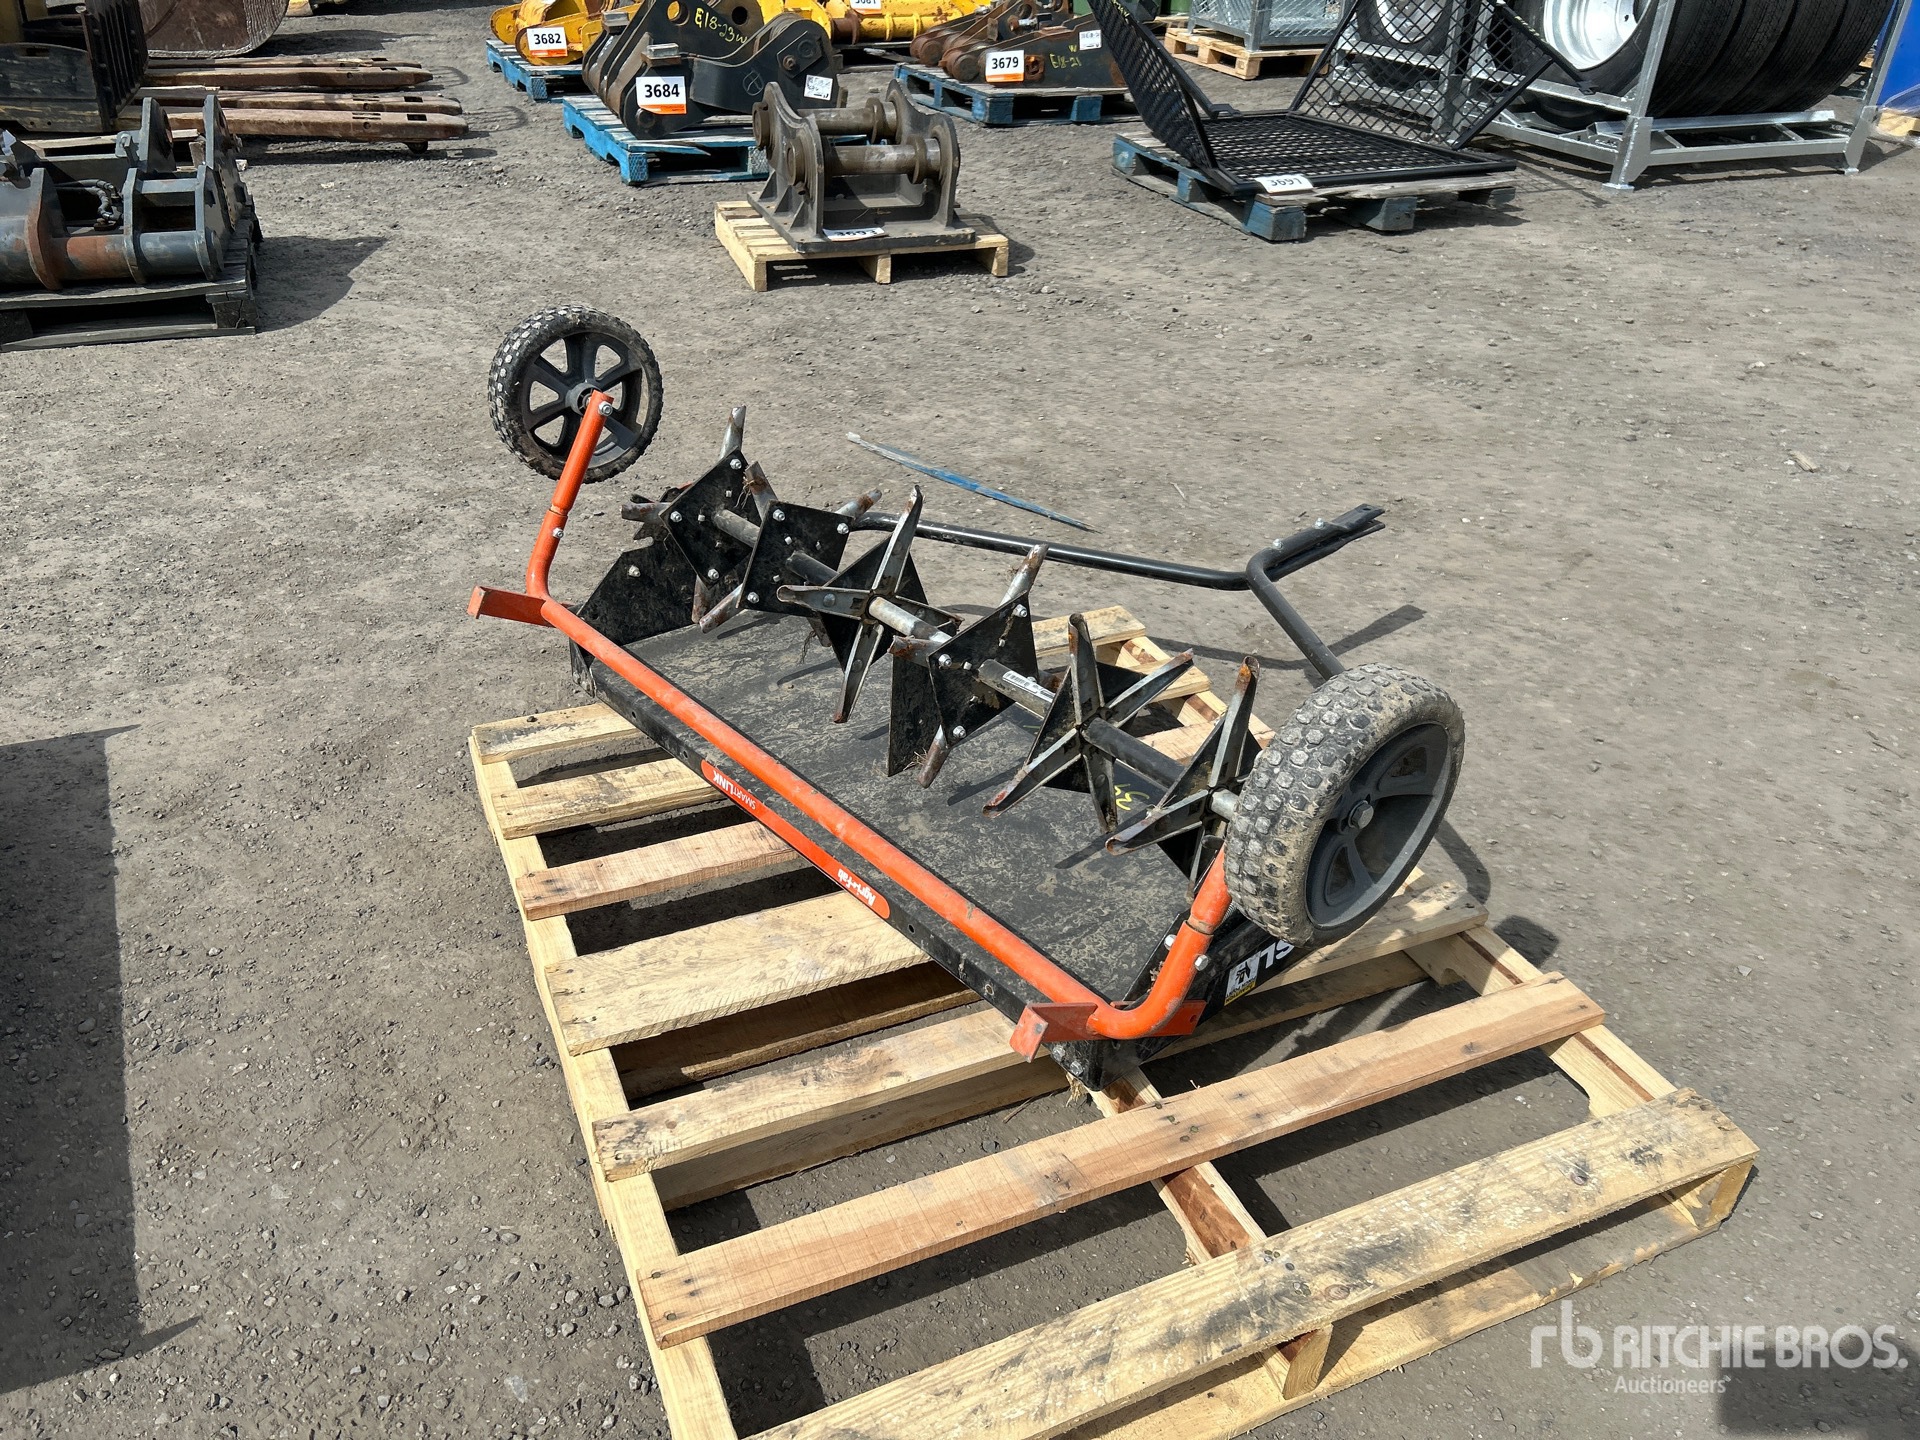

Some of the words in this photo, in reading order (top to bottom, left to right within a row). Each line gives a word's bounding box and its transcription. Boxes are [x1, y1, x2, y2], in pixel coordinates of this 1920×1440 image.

[533, 33, 562, 45] 3682
[991, 56, 1019, 70] 3679
[644, 83, 680, 98] 3684
[1269, 177, 1303, 187] 3691
